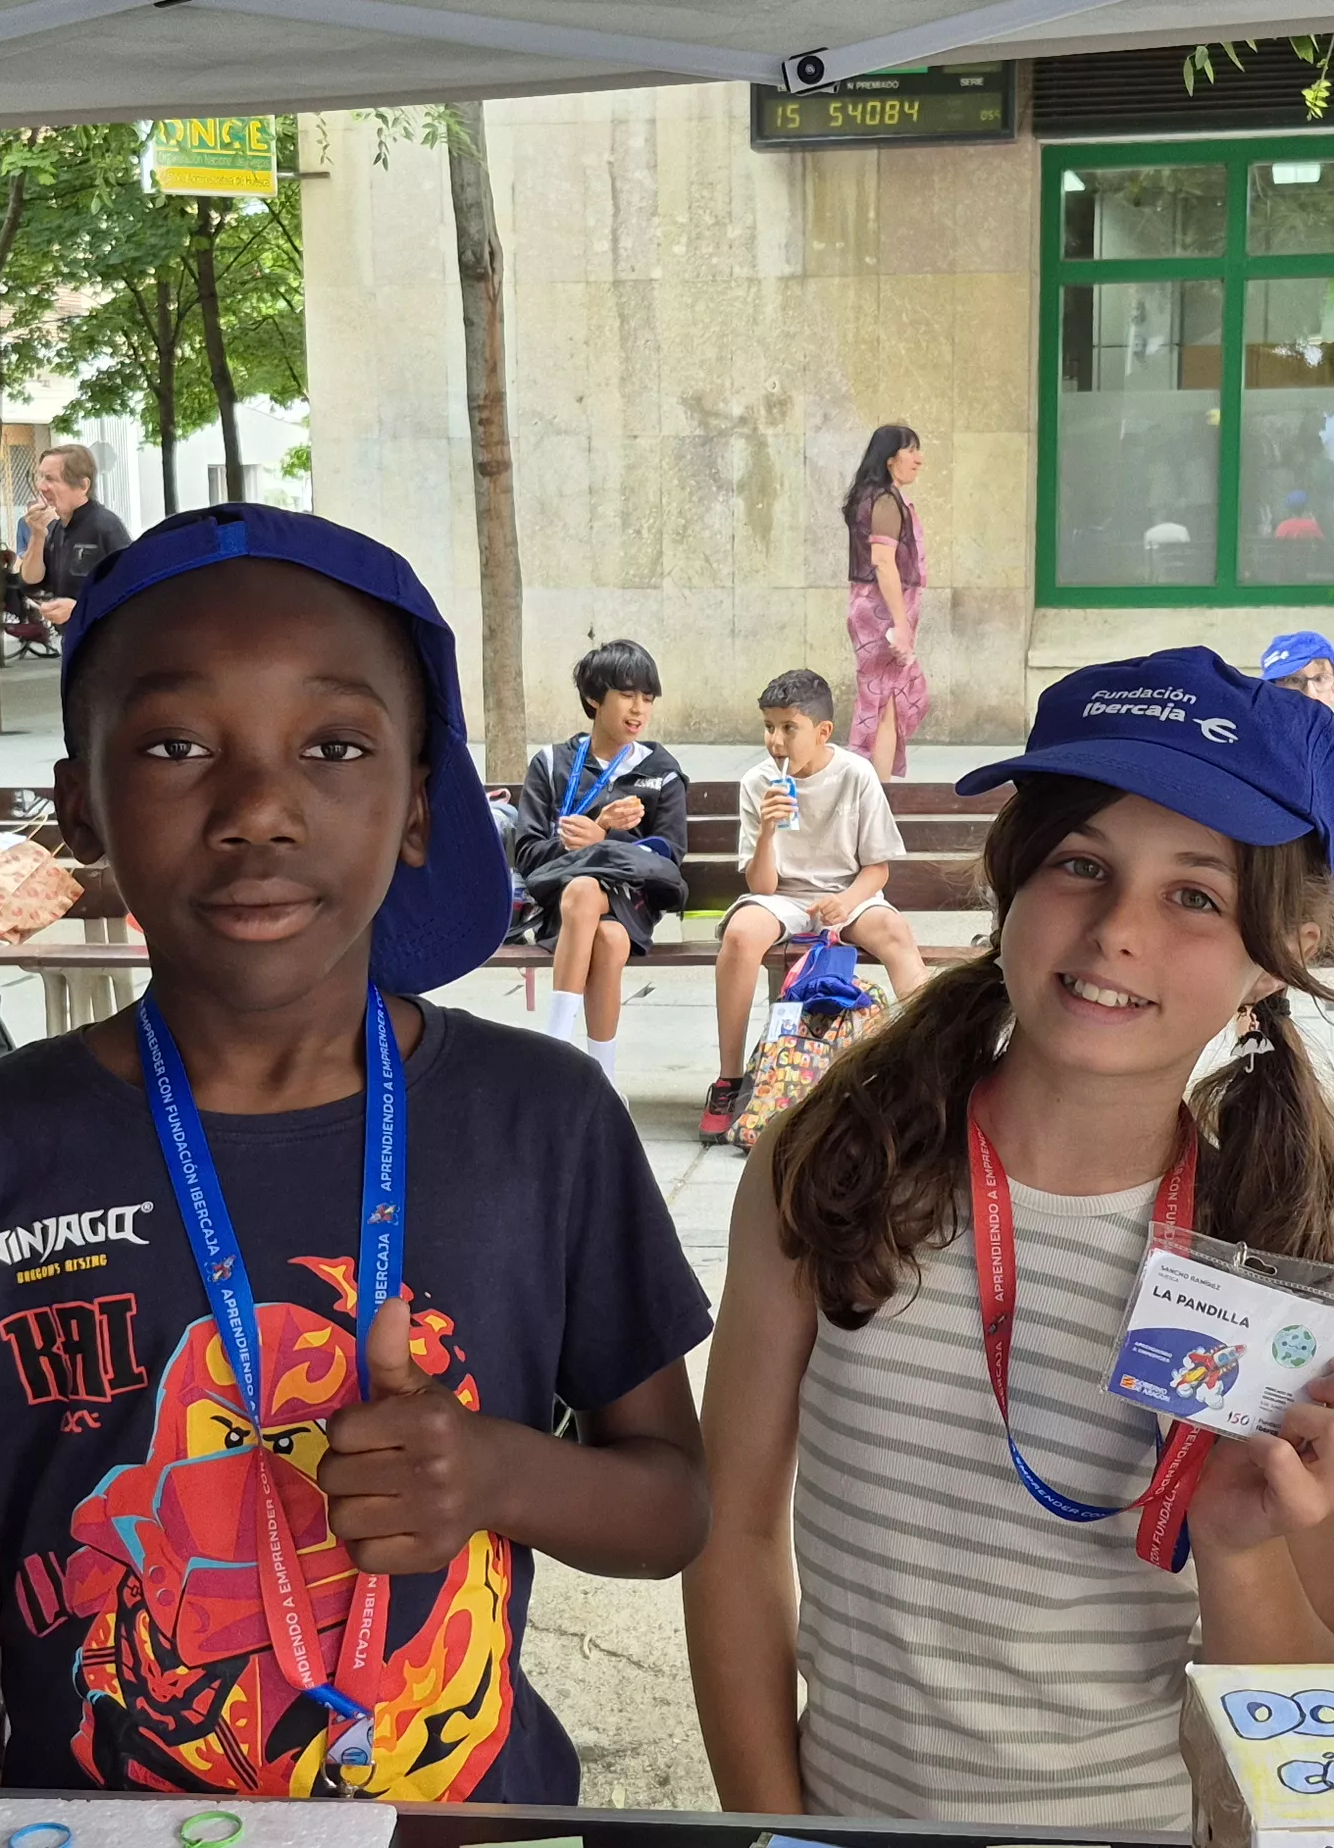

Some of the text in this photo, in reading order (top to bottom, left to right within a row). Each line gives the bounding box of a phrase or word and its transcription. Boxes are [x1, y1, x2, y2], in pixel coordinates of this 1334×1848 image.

[855, 80, 900, 90] PREMIADO
[960, 77, 984, 87] SERIE
[776, 101, 920, 128] 15 54084
[158, 118, 269, 150] ONCE
[1091, 686, 1197, 704] Fundación
[1082, 701, 1186, 722] Ibercaja
[379, 1008, 394, 1079] EMPRENDER
[380, 1078, 394, 1090] A
[139, 1006, 222, 1256] EMPRENDER CON FUNDACIÓN IBERCAJA
[380, 1094, 394, 1192] APRENDIENDO
[1168, 1176, 1180, 1202] CON
[979, 1128, 1004, 1302] APRENDIENDO A EMPREND
[17, 1254, 108, 1284] DRAGONS RISING
[372, 1232, 391, 1302] IBERCAJA
[1160, 1264, 1190, 1280] SANCHO
[1152, 1286, 1250, 1328] LA PANDILLA
[221, 1289, 254, 1396] APRENDIENDO
[266, 1499, 292, 1596] EMPRENDER
[282, 1596, 294, 1608] A
[352, 1590, 376, 1672] IBERCAJA
